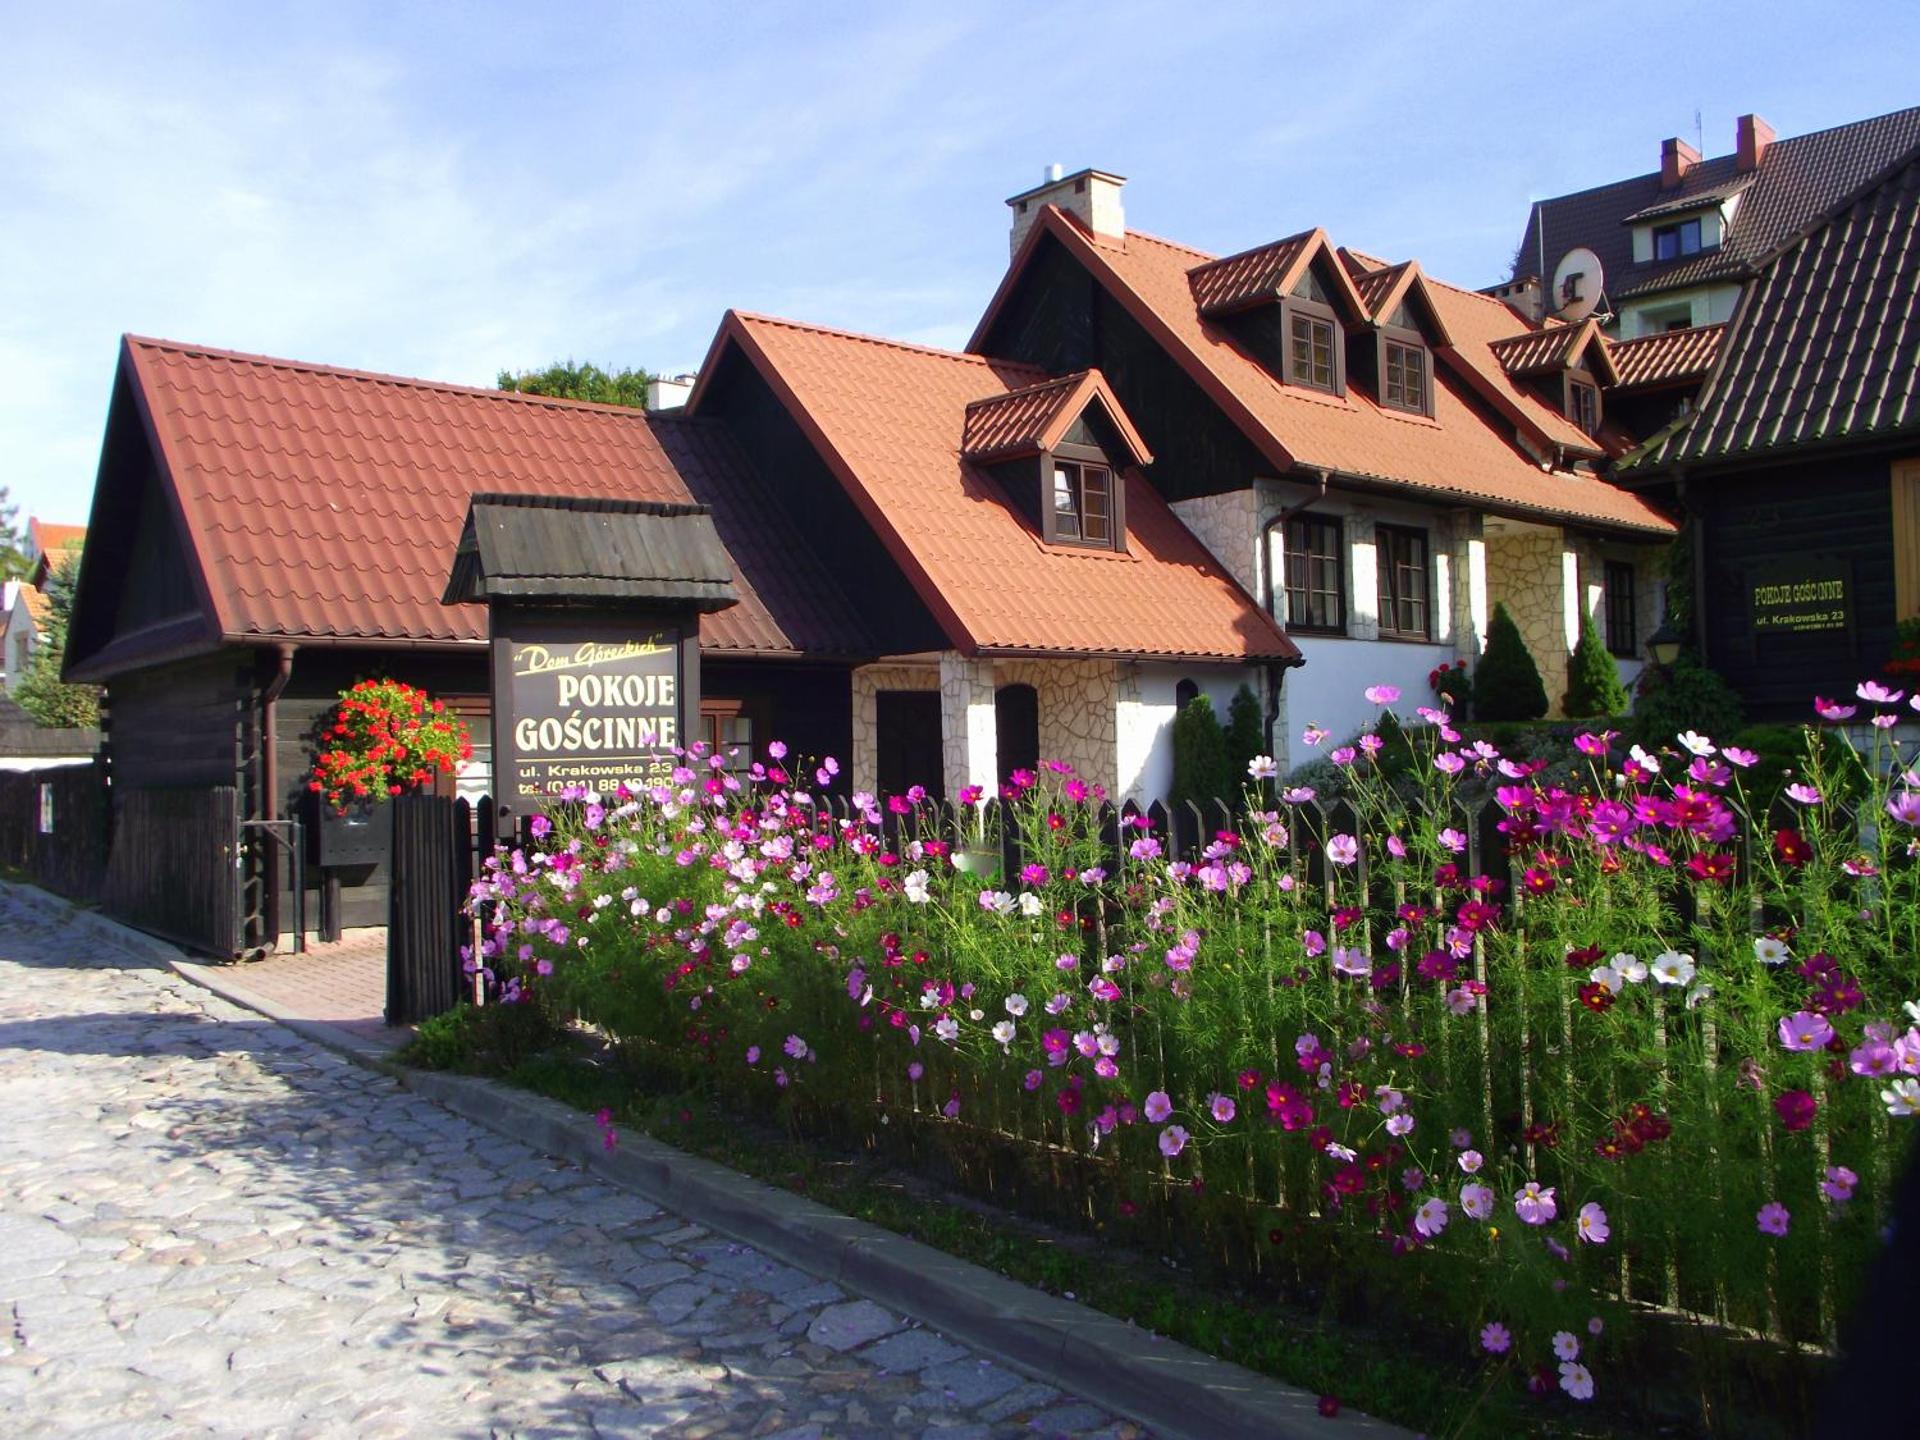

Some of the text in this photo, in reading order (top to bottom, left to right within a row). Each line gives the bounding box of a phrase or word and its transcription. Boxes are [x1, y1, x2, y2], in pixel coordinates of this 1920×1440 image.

[1754, 585, 1791, 606] POKOJE
[1772, 613, 1829, 624] Krakowska
[1832, 611, 1845, 620] 23
[558, 674, 675, 707] POKOJE
[515, 710, 676, 752] GOŚCINNE
[519, 762, 673, 777] ul. Krakowska 23
